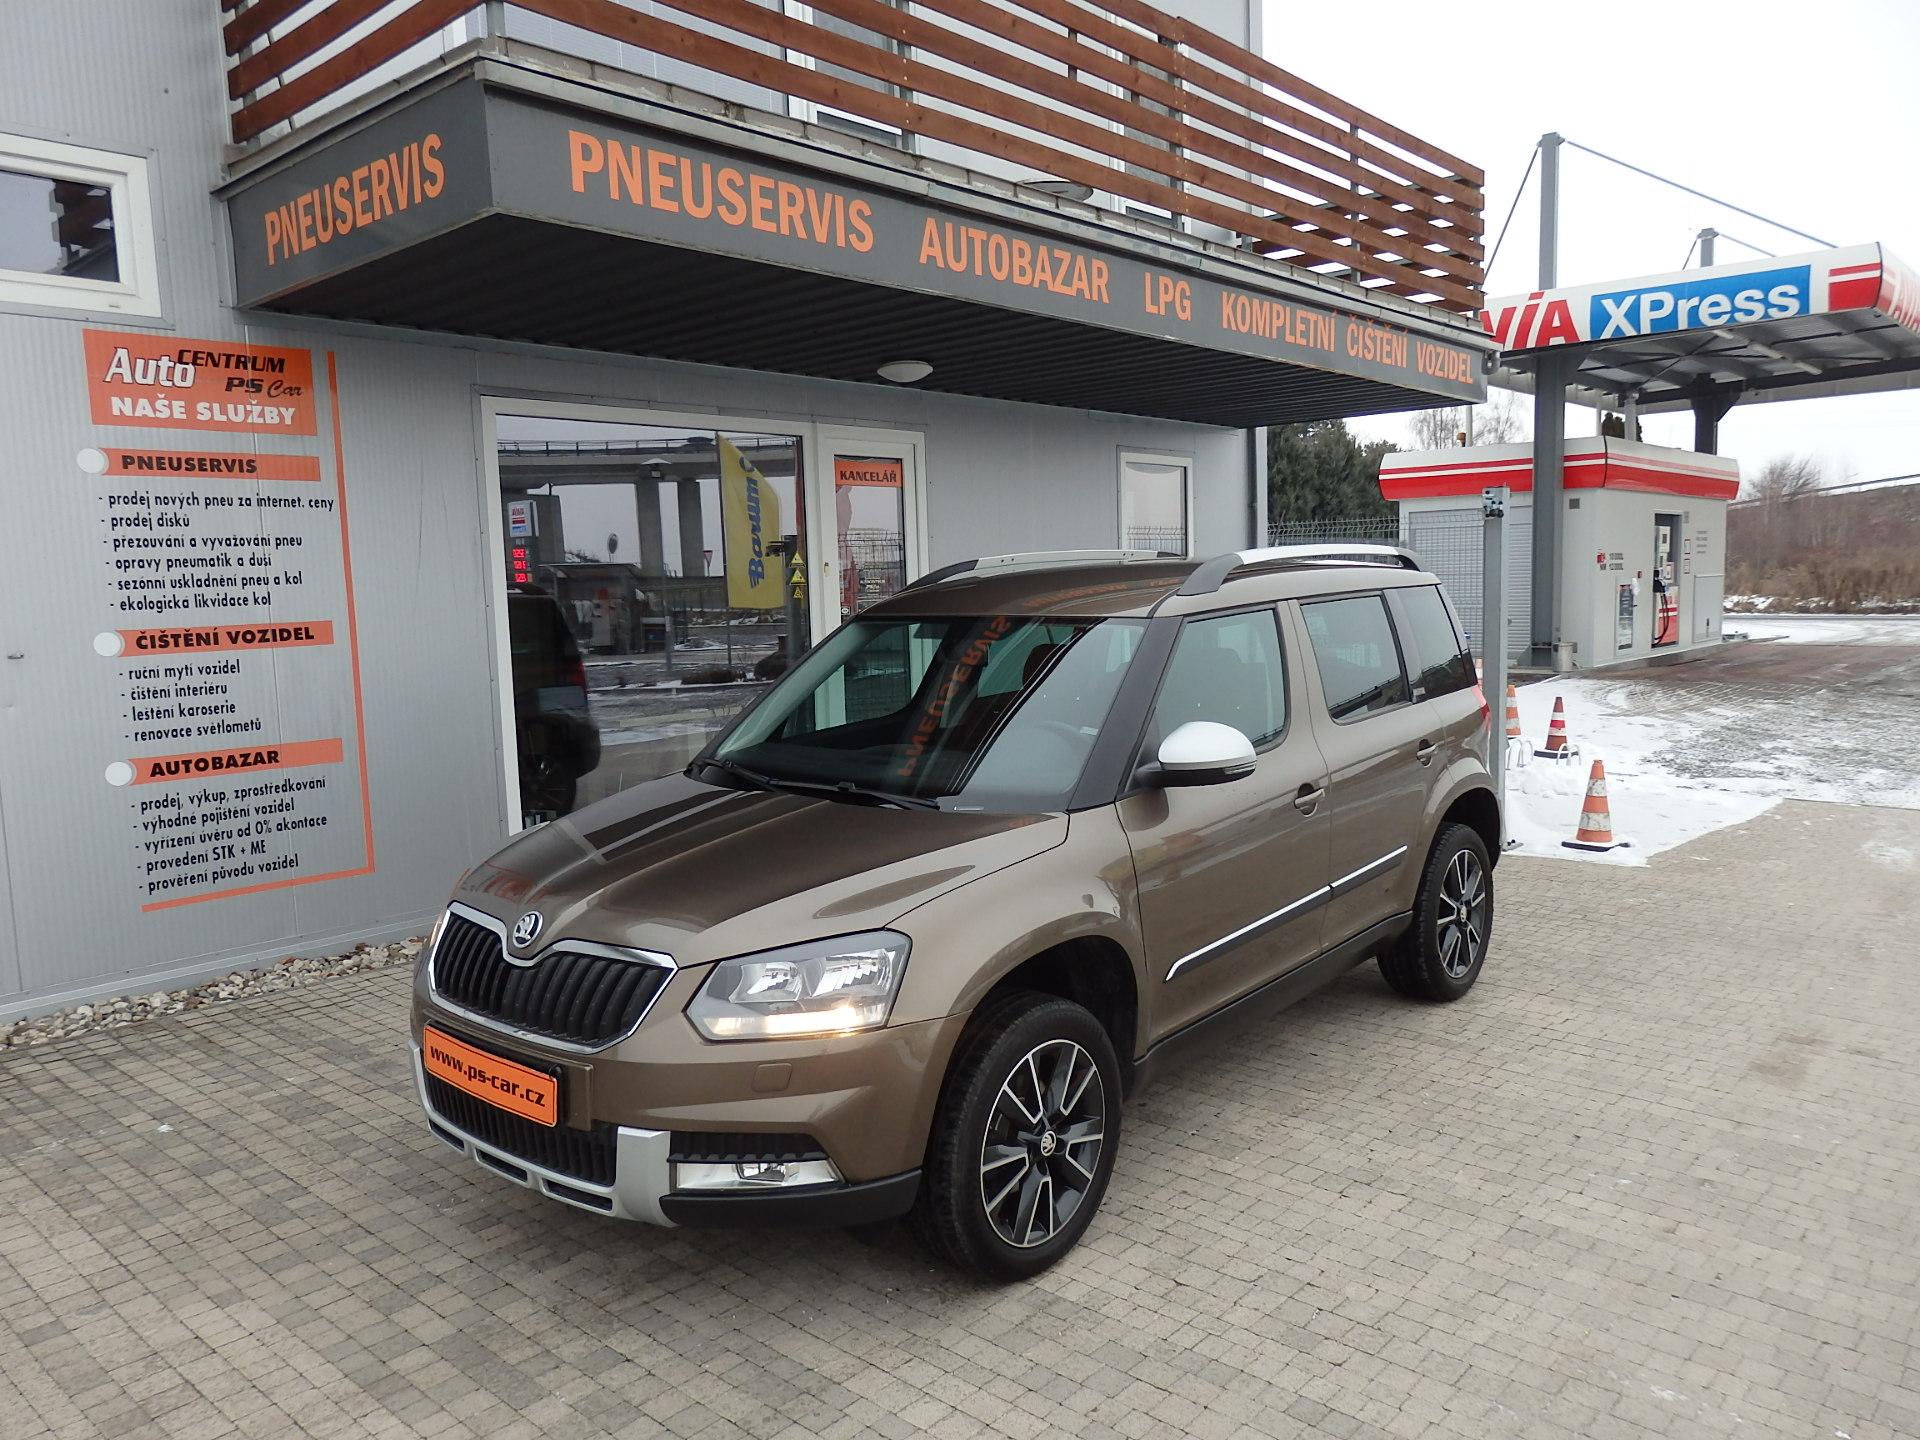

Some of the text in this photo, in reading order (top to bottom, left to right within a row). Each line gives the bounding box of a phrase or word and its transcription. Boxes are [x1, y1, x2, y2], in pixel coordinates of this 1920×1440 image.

[264, 133, 446, 267] PNEUSERVIS
[568, 129, 1475, 385] PNEUSERVIS AUTOBAZAR LPG KOMPLETNÍ ČIŠTĚNÍ VOZIDEL
[1599, 283, 1800, 340] XPress
[103, 346, 286, 388] Auto CENTRUM
[224, 376, 304, 398] PS Car
[110, 393, 296, 425] NAŠE SLUŽBY
[121, 454, 258, 474] PNEUSERVIS
[840, 470, 897, 483] KANCELÁŘ
[108, 490, 334, 512] prodej nových pneu za internet. ceny
[111, 512, 190, 531] prodej disků
[745, 476, 765, 589] Barum
[113, 534, 303, 552] přezouvání a vyvažování pneu
[116, 552, 272, 573] opravy pneumatik a duší
[118, 570, 303, 590] sezónní uskladnění pneu a kol
[120, 591, 271, 613] ekologická likvidace kol
[136, 626, 315, 650] ČIŠTĚNÍ VOZIDEL
[129, 658, 241, 680] ruční mytí vozidel
[131, 681, 227, 701] čištění interiéru
[132, 699, 236, 721] leštění karoserie
[135, 718, 262, 741] renovace světlometů
[149, 750, 280, 778] AUTOBAZAR
[140, 776, 327, 815] prodej, výkup, zprostředkování
[142, 797, 295, 834] výhodné pojištění vozidel
[144, 816, 328, 855] vyřízení úvěru od 0% akontace
[146, 850, 209, 876] provedení
[212, 844, 236, 861] STK
[250, 840, 267, 855] ME
[148, 853, 299, 895] prověření původu vozidel
[429, 1044, 547, 1107] www.ps-car.cz
